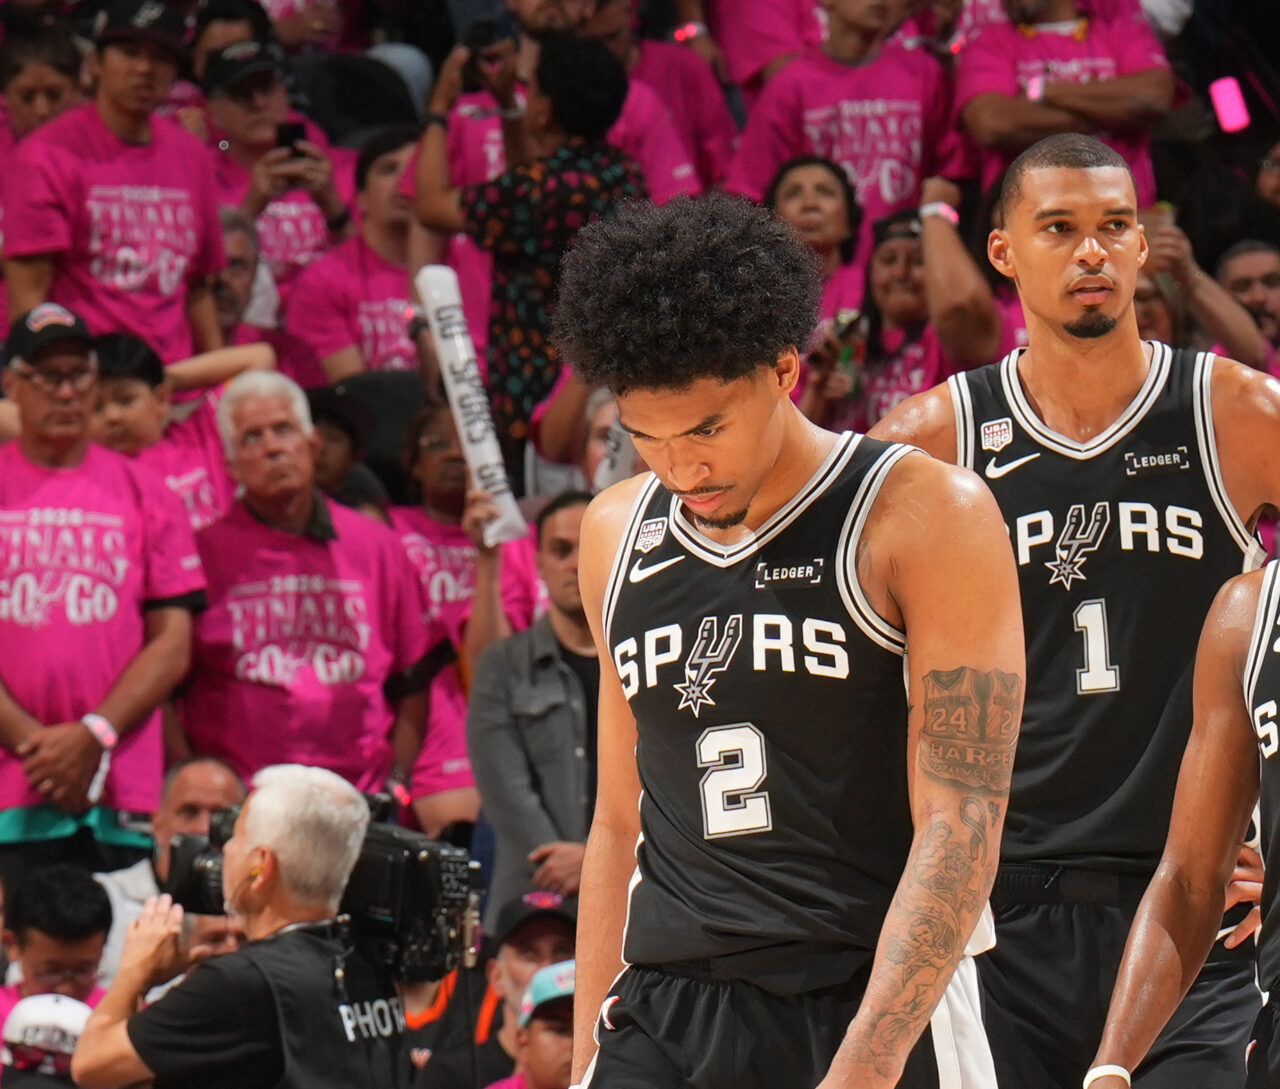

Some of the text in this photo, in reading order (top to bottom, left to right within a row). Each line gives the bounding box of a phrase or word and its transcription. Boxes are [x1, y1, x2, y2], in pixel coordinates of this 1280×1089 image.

[984, 422, 1009, 435] USA
[1133, 452, 1181, 469] LEDGER
[642, 521, 665, 533] USA
[1004, 501, 1204, 591] PURS
[0, 526, 128, 586] INALS
[763, 565, 814, 582] LEDGER
[65, 572, 118, 626] GO
[614, 614, 850, 718] SPURS
[1072, 598, 1120, 695] 1
[930, 705, 969, 733] 24
[695, 722, 773, 840] 2
